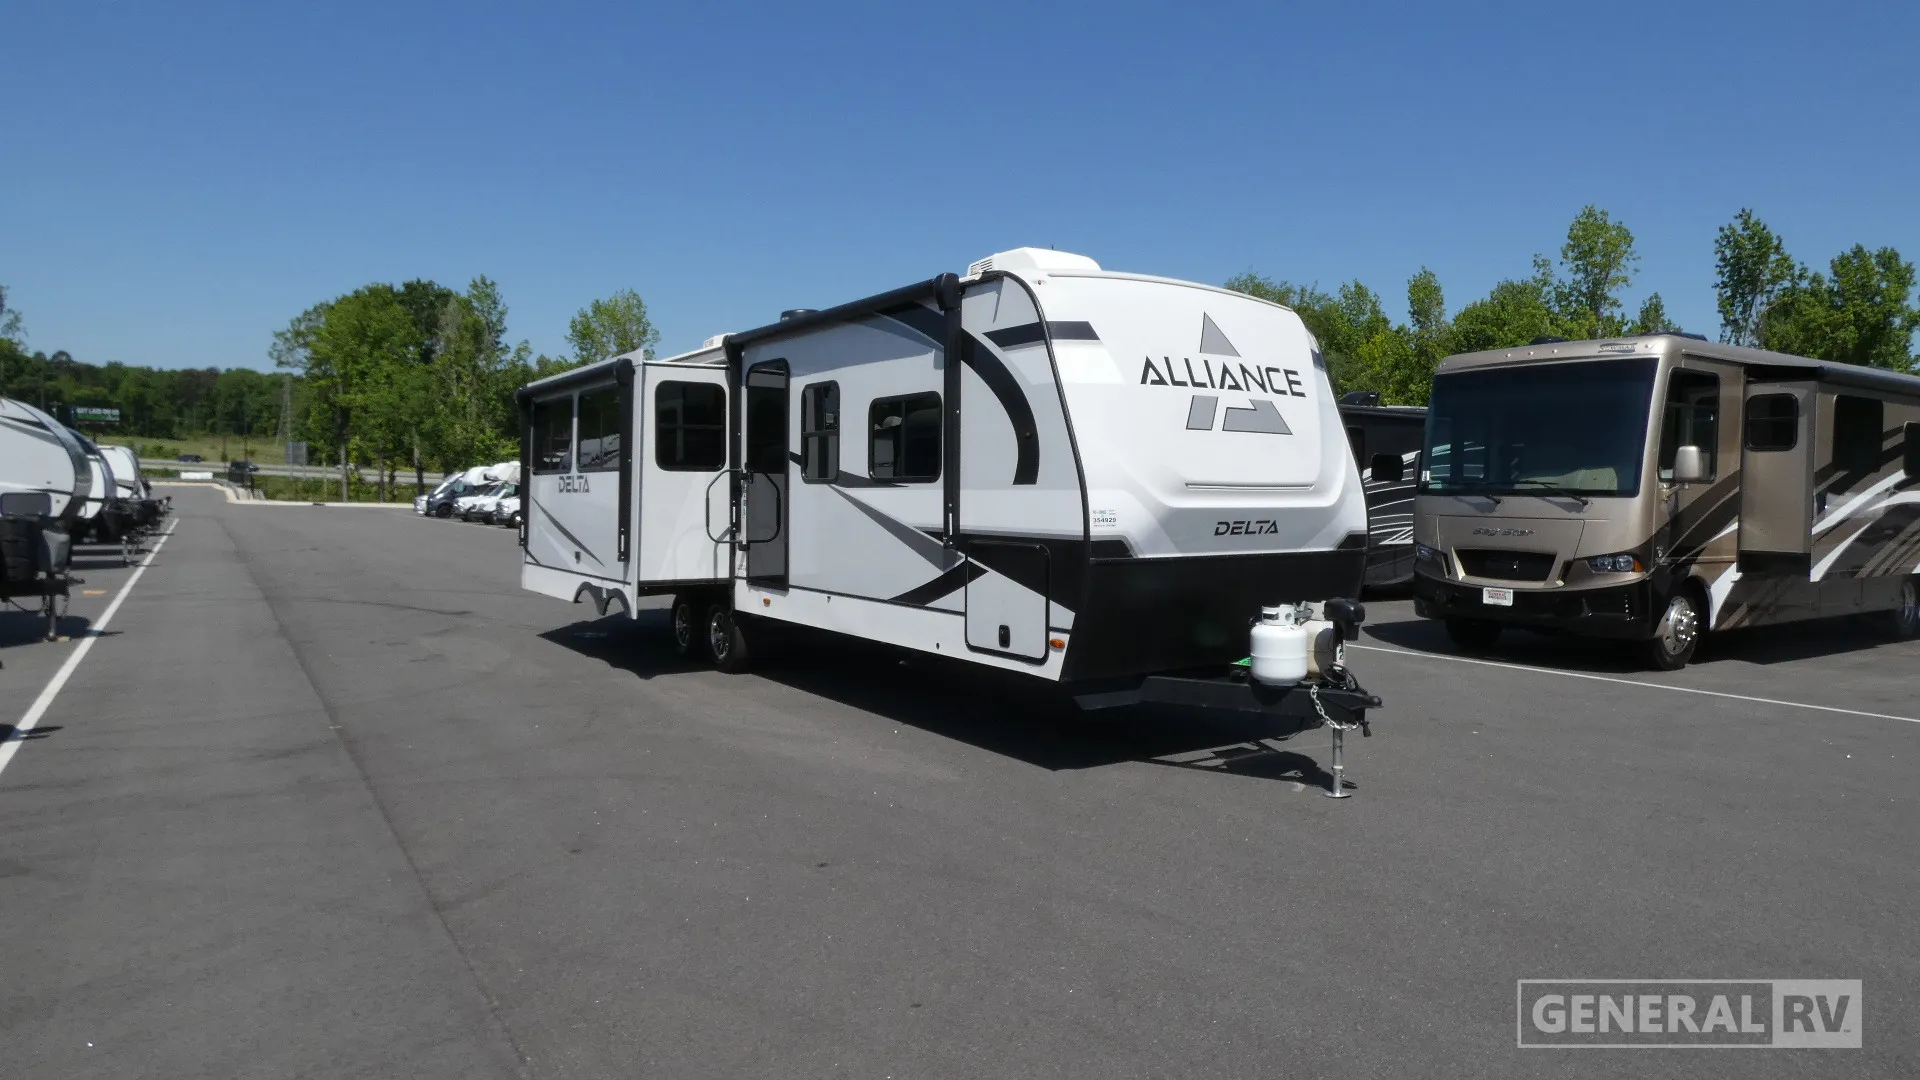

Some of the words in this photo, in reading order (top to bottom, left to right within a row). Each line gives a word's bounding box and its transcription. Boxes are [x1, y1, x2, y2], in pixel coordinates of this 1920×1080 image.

[1140, 355, 1306, 397] ALLIANCE
[558, 475, 590, 493] DELTA
[1214, 519, 1279, 536] DELTA
